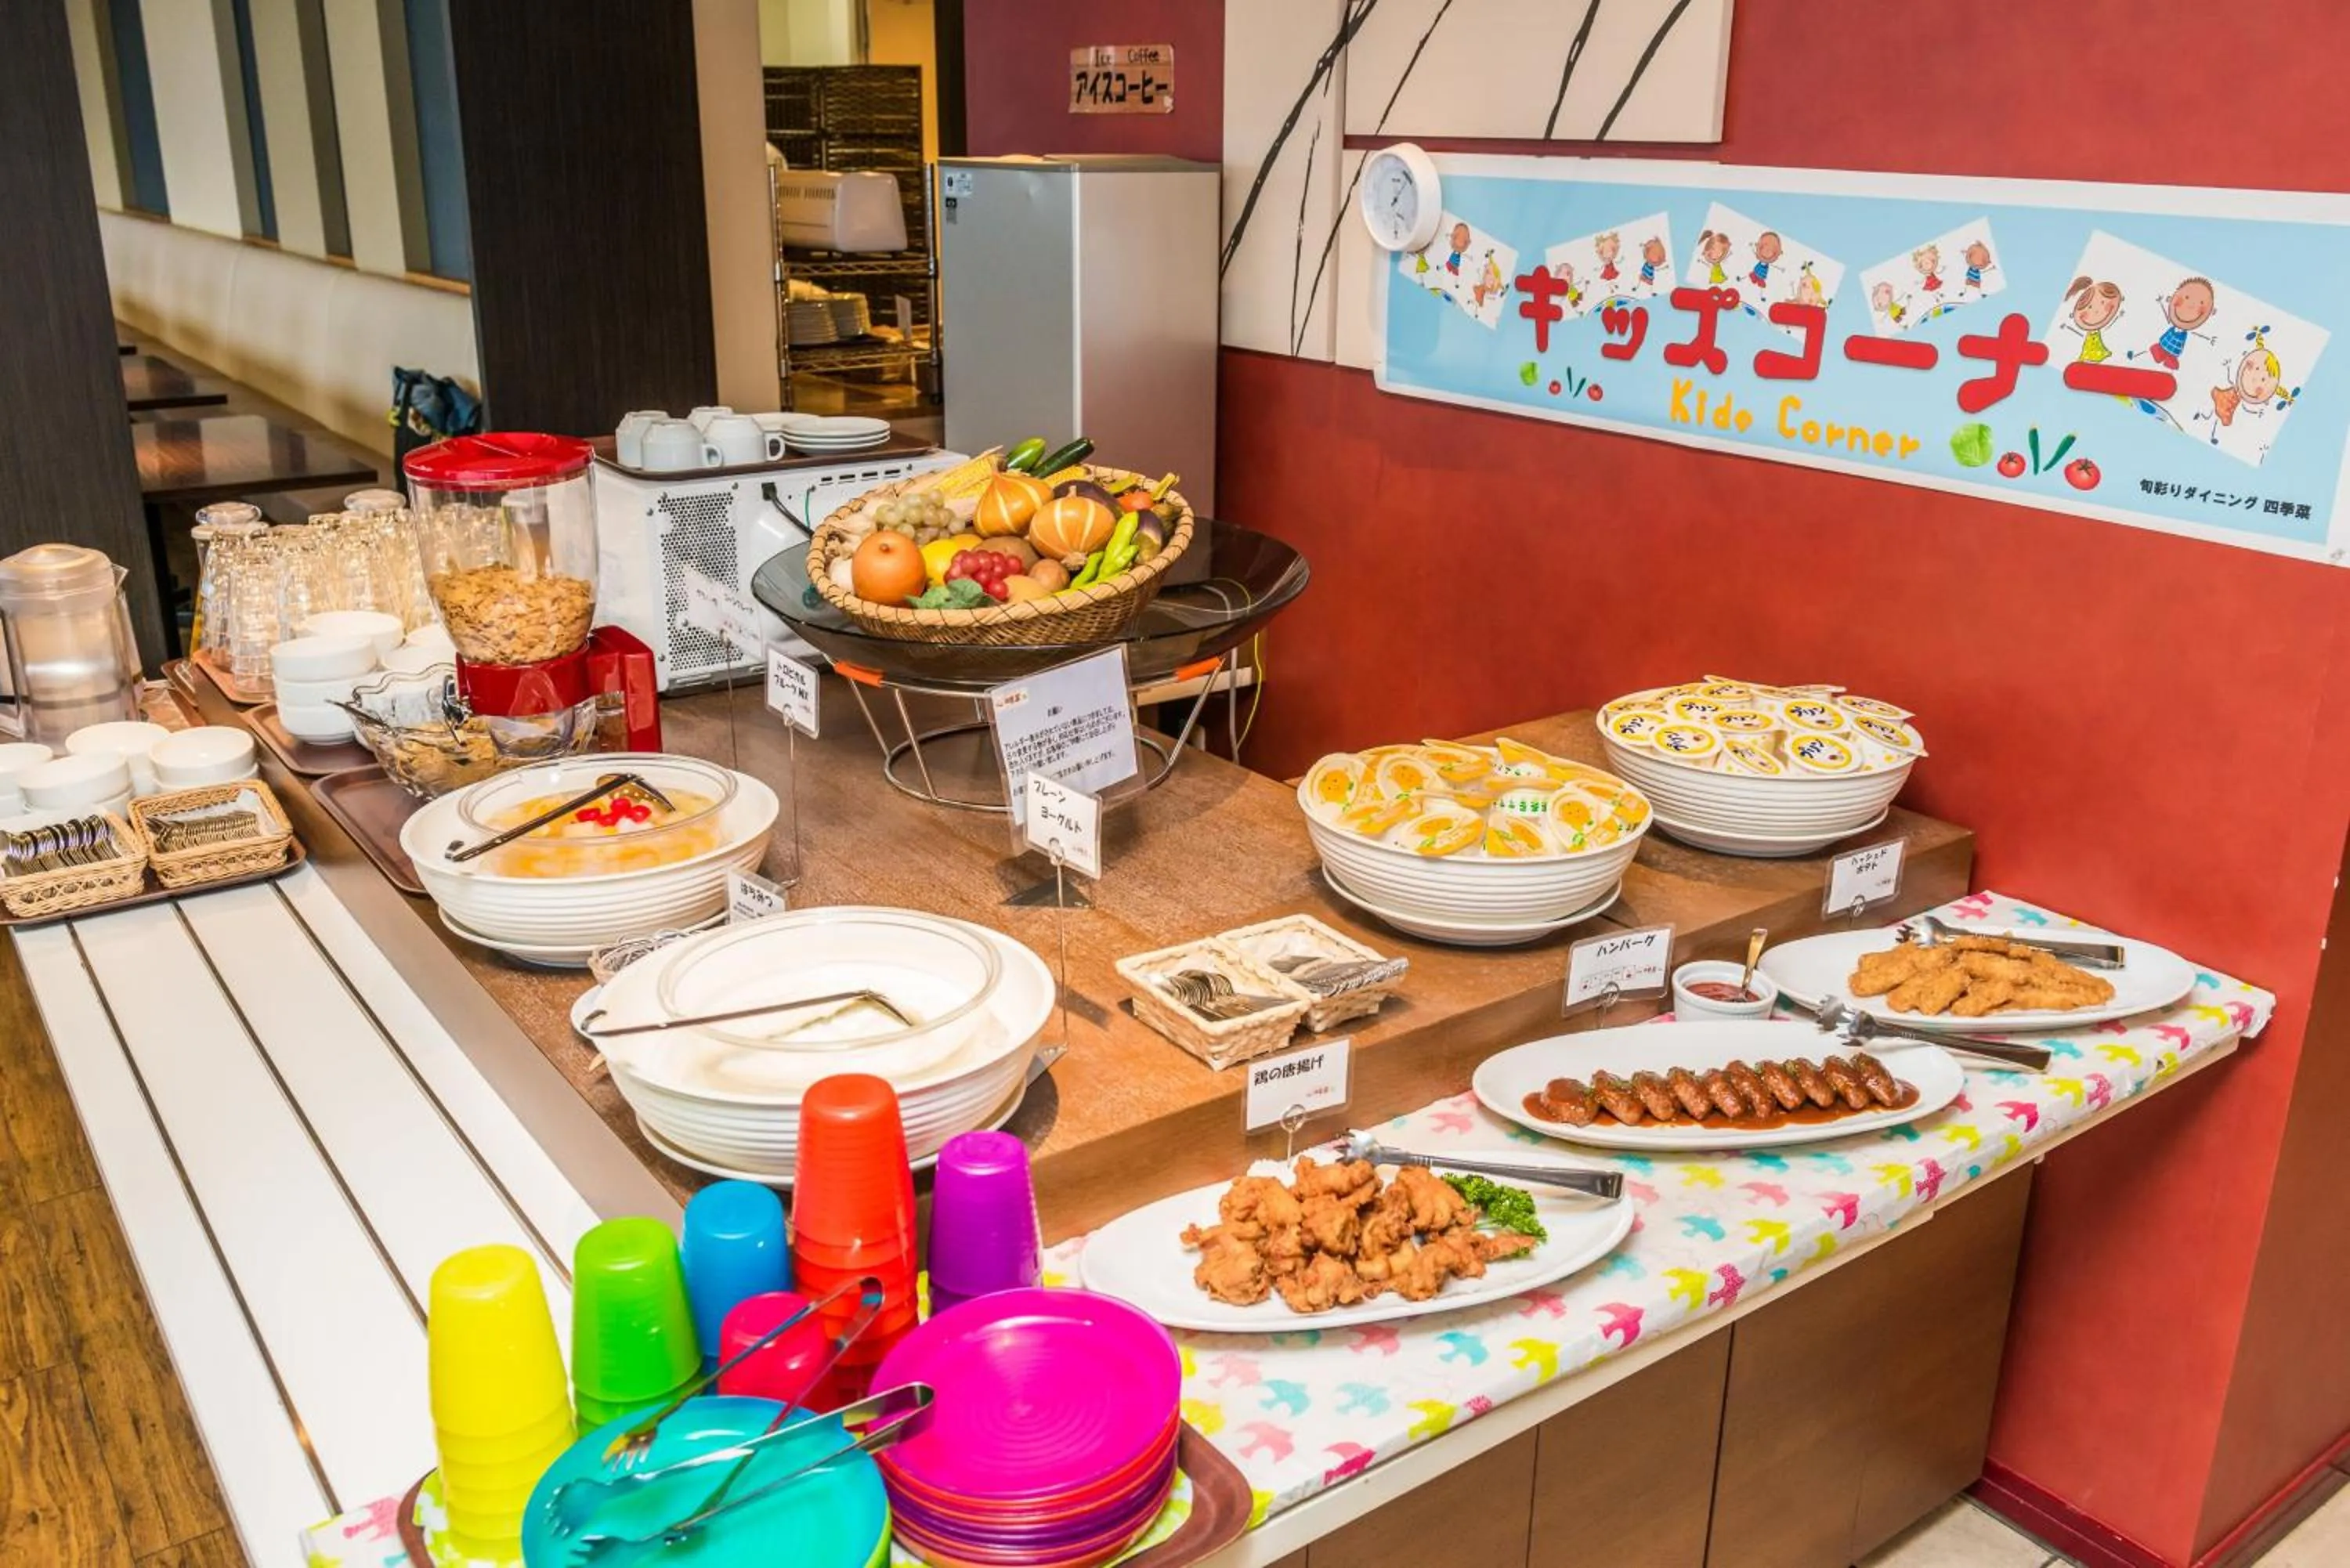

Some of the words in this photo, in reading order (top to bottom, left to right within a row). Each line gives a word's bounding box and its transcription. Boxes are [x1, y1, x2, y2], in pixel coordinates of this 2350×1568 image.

[1095, 49, 1112, 67] Ice
[1128, 49, 1160, 64] Coffee
[1076, 70, 1168, 104] アイスコーヒー
[1515, 266, 2177, 414] キッズコーナー
[1778, 395, 1921, 459] Corner
[2140, 479, 2258, 510] 旬彩りダイニング
[2263, 499, 2312, 520] 四季菜
[1041, 806, 1083, 833] ヨーグルト
[1596, 934, 1656, 957] ハンバーグ
[1254, 1054, 1325, 1086] 鶏の唐揚げ
